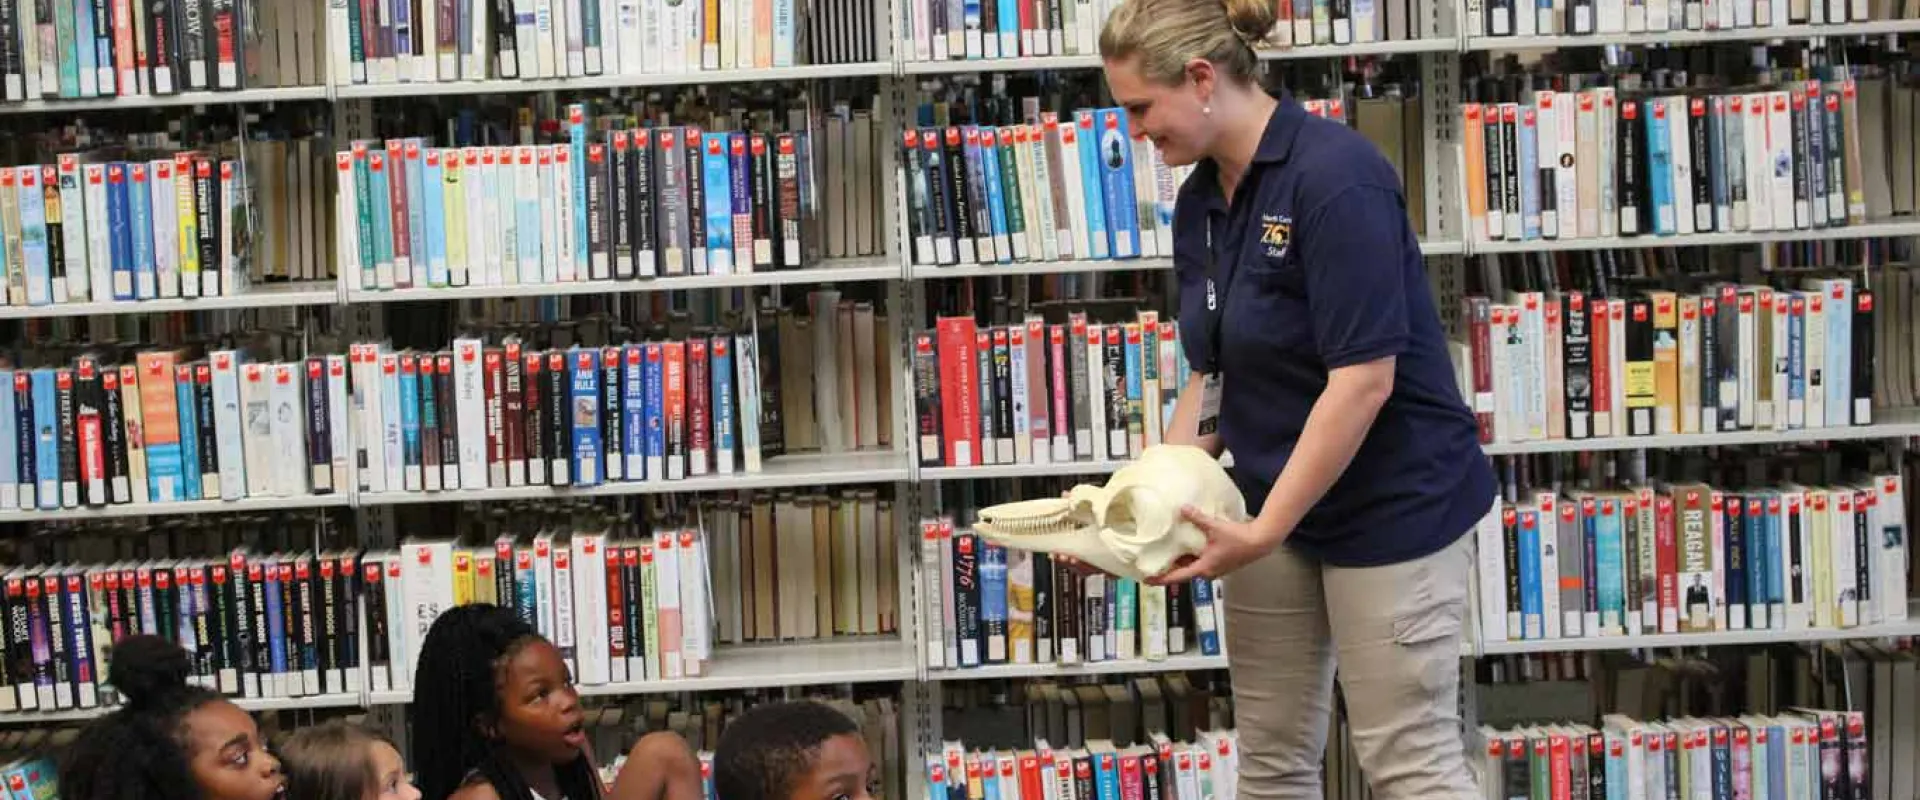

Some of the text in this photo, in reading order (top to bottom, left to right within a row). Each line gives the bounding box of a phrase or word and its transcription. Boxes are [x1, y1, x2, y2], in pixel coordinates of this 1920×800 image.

[1624, 103, 1634, 112] LP
[1692, 100, 1703, 108] LP
[1080, 112, 1091, 121] LP
[1106, 112, 1116, 121] LP
[615, 134, 626, 142] LP
[636, 130, 646, 139] LP
[662, 132, 672, 141] LP
[688, 130, 698, 138] LP
[906, 130, 916, 139] LP
[982, 130, 993, 139] LP
[732, 139, 743, 148] LP
[134, 166, 144, 174] LP
[198, 161, 208, 170] LP
[110, 166, 121, 175] LP
[1860, 294, 1870, 303] LP
[1704, 299, 1714, 308] LP
[1635, 305, 1646, 314] LP
[995, 330, 1006, 338] LP
[1108, 328, 1118, 336] LP
[918, 336, 929, 344] LP
[978, 334, 989, 342] LP
[508, 344, 518, 352] LP
[628, 348, 639, 356] LP
[648, 345, 658, 354] LP
[692, 343, 703, 352] LP
[580, 352, 590, 361] LP
[606, 350, 617, 359] LP
[80, 360, 90, 369] LP
[422, 357, 432, 366] LP
[439, 357, 450, 366] LP
[528, 356, 538, 364] LP
[198, 366, 208, 374] LP
[16, 374, 26, 383] LP
[59, 372, 70, 381] LP
[104, 374, 115, 382] LP
[1688, 492, 1698, 500] LP
[1712, 496, 1722, 504] LP
[1728, 500, 1739, 508] LP
[1750, 500, 1760, 508] LP
[1504, 509, 1515, 518] LP
[1684, 510, 1704, 572] REAGAN
[499, 543, 510, 552] LP
[232, 554, 242, 562] LP
[607, 550, 618, 558] LP
[625, 550, 636, 558] LP
[297, 562, 308, 571] LP
[321, 560, 332, 569] LP
[342, 558, 352, 566] LP
[176, 568, 186, 577] LP
[192, 568, 202, 577] LP
[214, 567, 224, 576] LP
[250, 564, 260, 573] LP
[367, 565, 378, 574] LP
[106, 574, 117, 582] LP
[123, 572, 134, 580] LP
[139, 570, 150, 579] LP
[157, 572, 168, 581] LP
[9, 578, 20, 587] LP
[28, 580, 38, 589] LP
[46, 577, 56, 586] LP
[68, 576, 79, 584] LP
[1850, 717, 1860, 726] LP
[1716, 728, 1726, 737] LP
[1649, 734, 1660, 743] LP
[1535, 740, 1546, 748] LP
[1102, 754, 1112, 762] LP
[12, 774, 22, 782] LP
